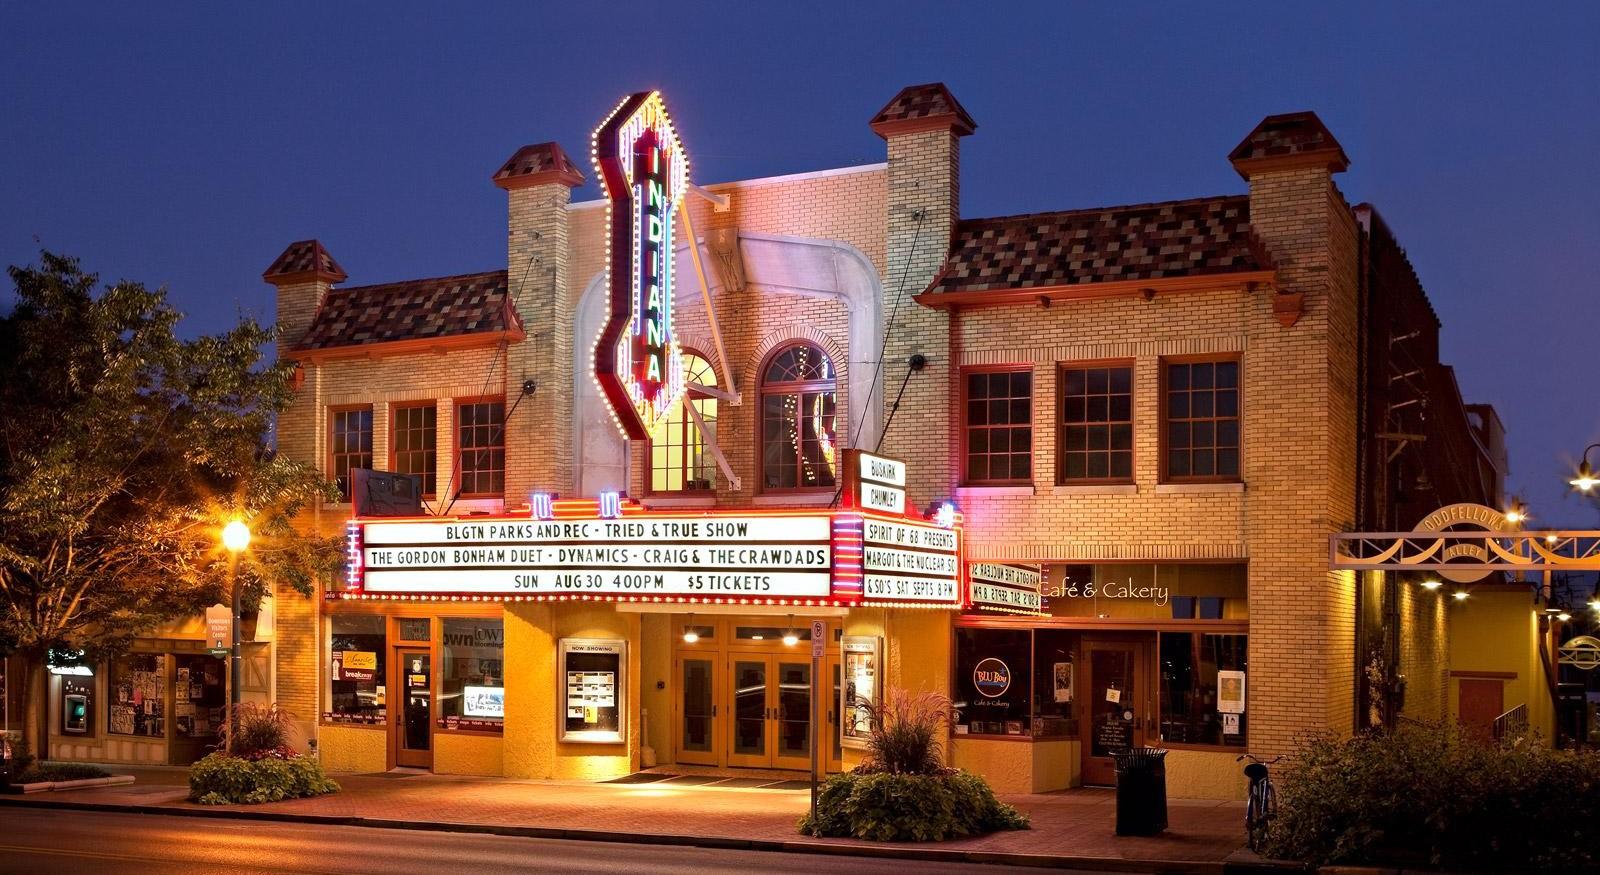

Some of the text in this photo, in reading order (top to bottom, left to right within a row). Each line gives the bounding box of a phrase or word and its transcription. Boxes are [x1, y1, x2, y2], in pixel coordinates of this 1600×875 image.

[649, 147, 662, 382] INDIANA
[871, 460, 896, 480] BUSKIRK
[871, 489, 897, 507] CHUMLEY
[1424, 506, 1505, 531] ODDFELLOWS
[446, 525, 484, 539] BLGTN
[490, 524, 533, 539] PARKS
[605, 523, 645, 538] TRIED
[651, 523, 659, 537] &
[663, 523, 699, 537] TRUE
[706, 522, 748, 537] SHOW
[869, 524, 953, 548] SPIRIT OF 68 PRESENTS
[371, 551, 393, 564] THE
[397, 550, 446, 564] GORDON
[454, 549, 505, 563] BONHAM
[511, 549, 543, 563] DUET
[559, 549, 629, 563] DYNAMICS
[643, 549, 688, 564] CRAIG
[692, 549, 701, 563] &
[1449, 545, 1481, 557] ALLEY
[866, 550, 895, 567] MARGOT
[896, 553, 901, 567] &
[902, 554, 915, 569] THE
[916, 556, 945, 571] NUCLEAR
[514, 575, 539, 588] SUN
[555, 574, 582, 588] AUG
[586, 574, 603, 588] 30
[688, 575, 704, 589] $5
[709, 576, 770, 591] TICKETS
[867, 578, 873, 593] &
[896, 580, 909, 595] SAT
[937, 583, 942, 596] 8
[1036, 577, 1168, 607] Café & Cakery
[977, 670, 993, 683] BLU
